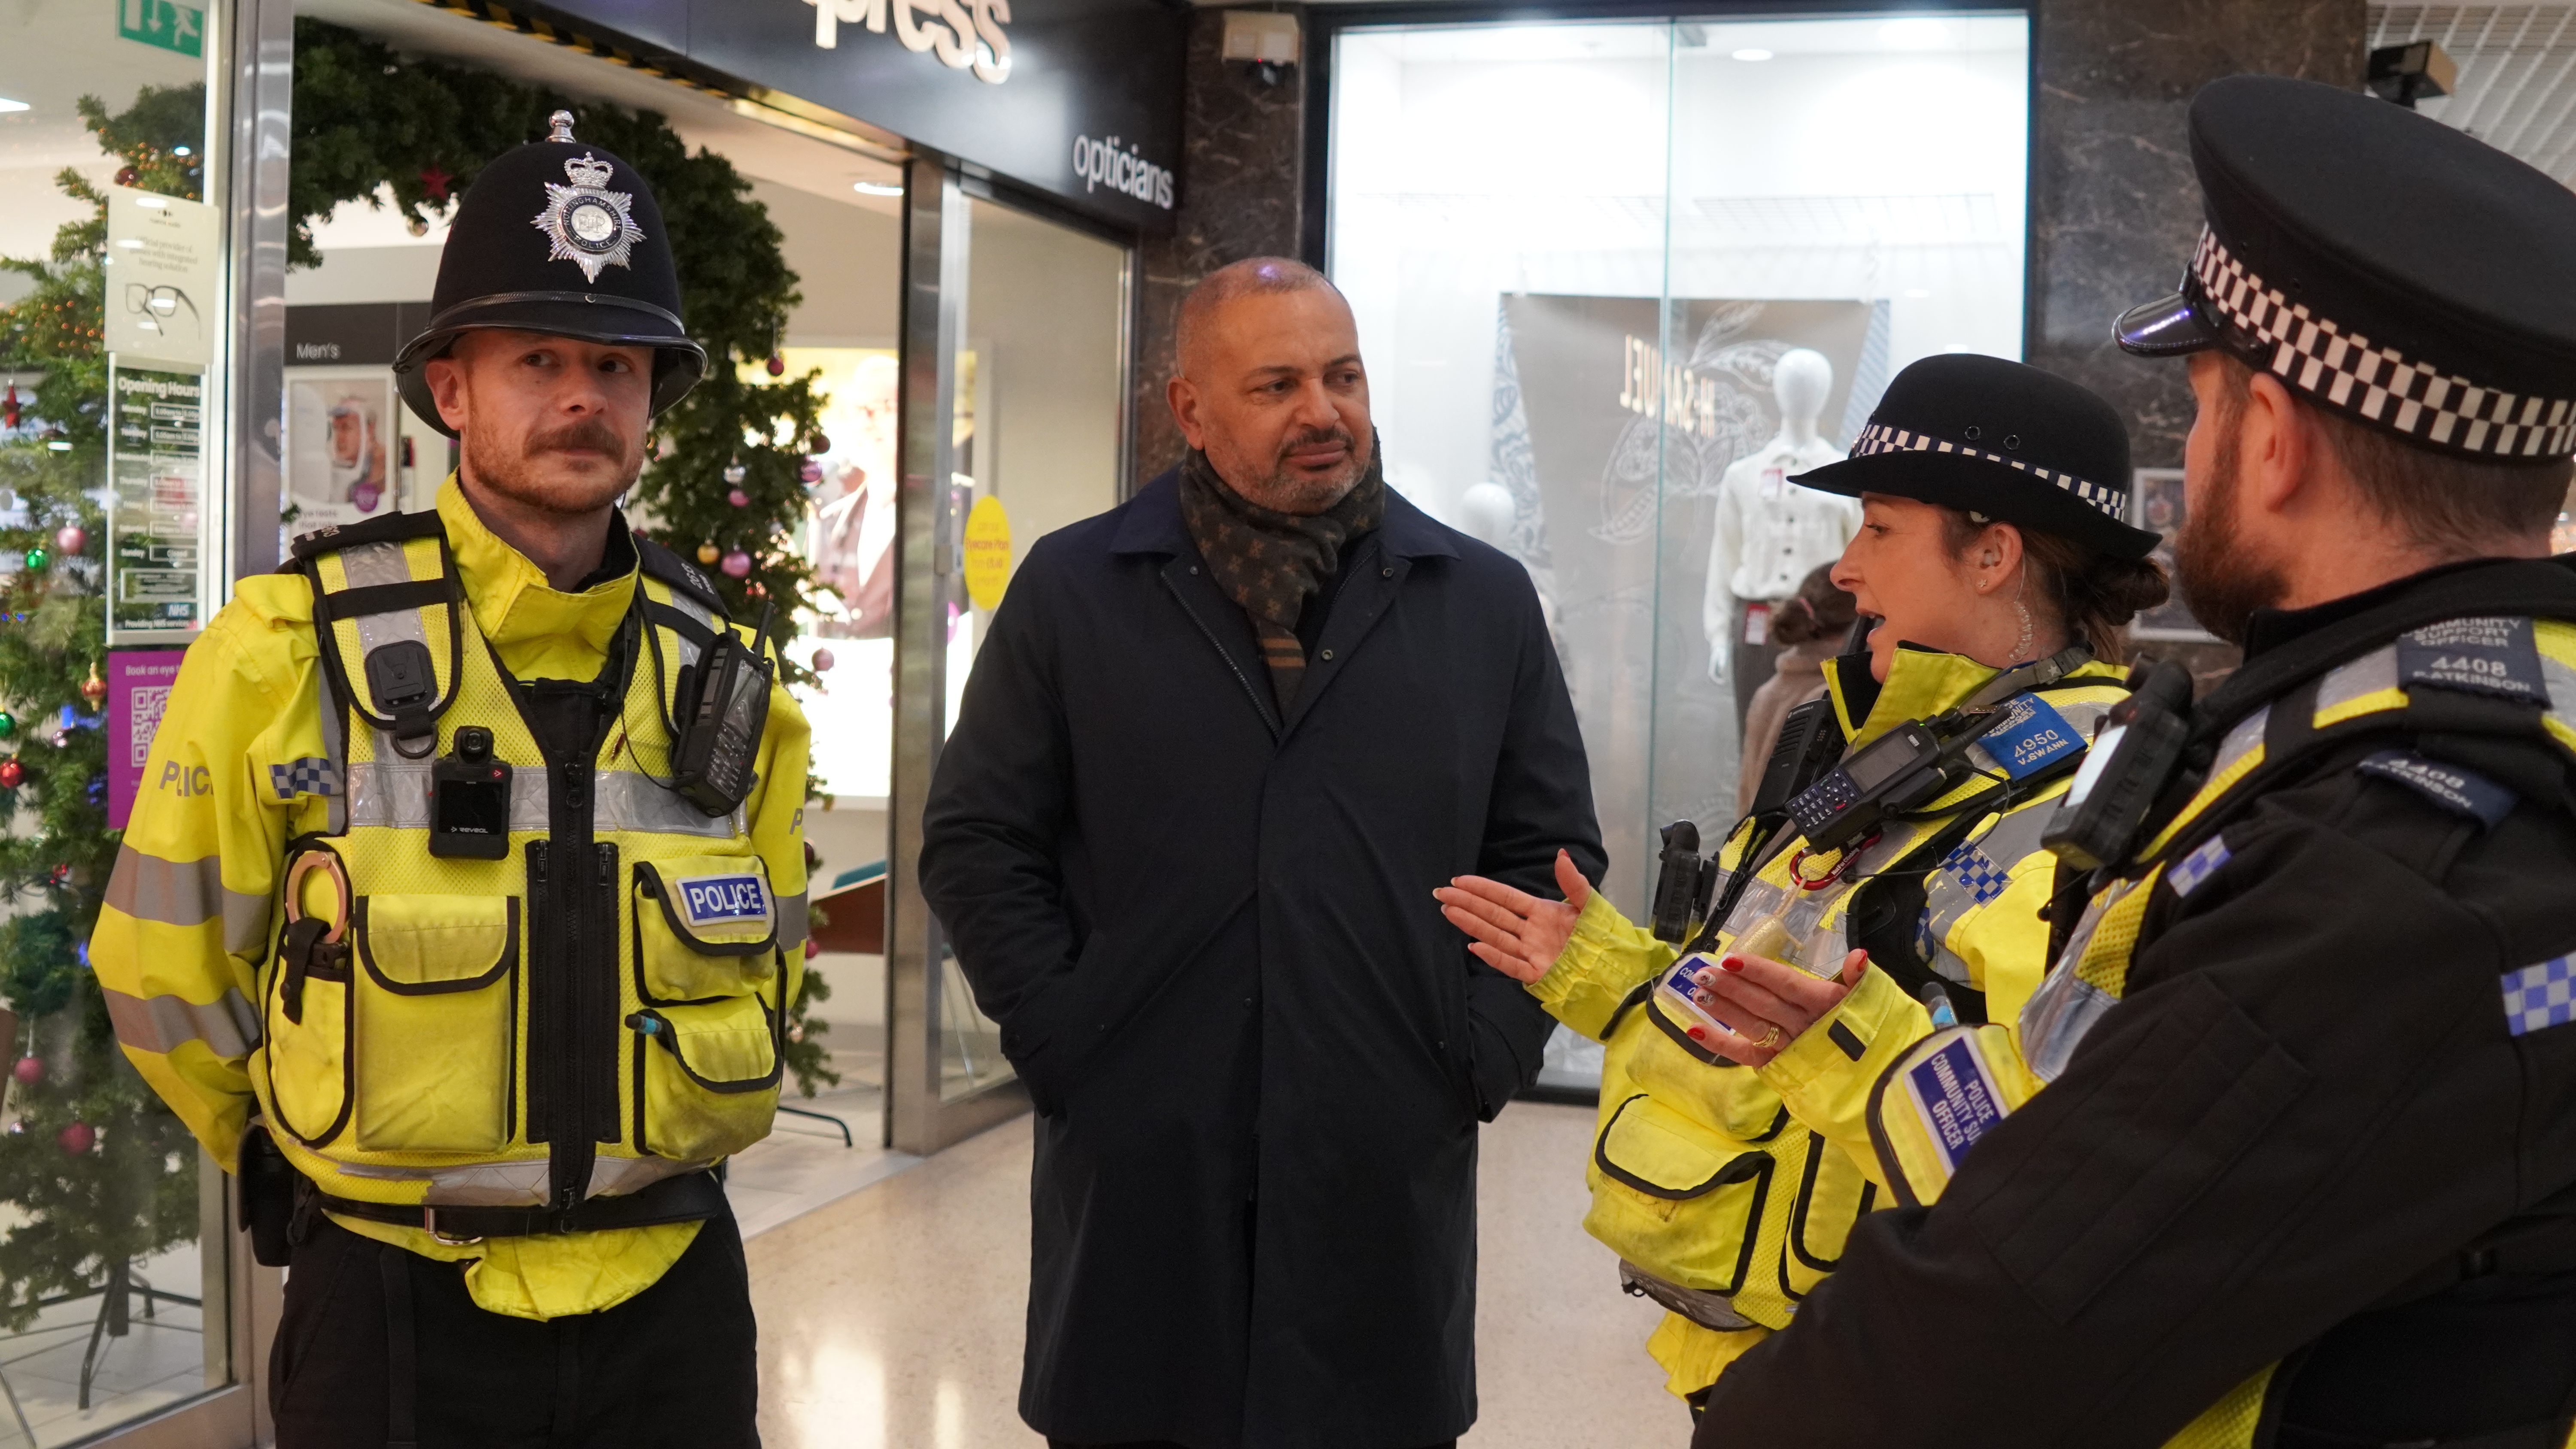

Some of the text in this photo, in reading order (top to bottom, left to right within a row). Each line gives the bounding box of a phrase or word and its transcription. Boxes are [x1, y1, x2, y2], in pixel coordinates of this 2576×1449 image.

[1074, 135, 1174, 209] opticians
[563, 196, 622, 231] NOTTINGHAMSHIRE
[574, 235, 613, 249] POLICE
[296, 343, 342, 360] Men's
[117, 376, 200, 399] Opening Hours
[125, 618, 153, 629] Providing
[168, 604, 190, 617] NHS
[125, 665, 146, 676] Book
[147, 667, 158, 676] an
[160, 667, 175, 677] eye
[2430, 656, 2507, 677] 4408
[2014, 729, 2059, 758] 4950
[2388, 758, 2465, 789] 4408
[689, 883, 761, 914] POLICE
[1932, 1053, 1974, 1123] COMMUNITY
[1964, 1079, 1996, 1124] POLICE
[1932, 1099, 1964, 1150] OFFICER
